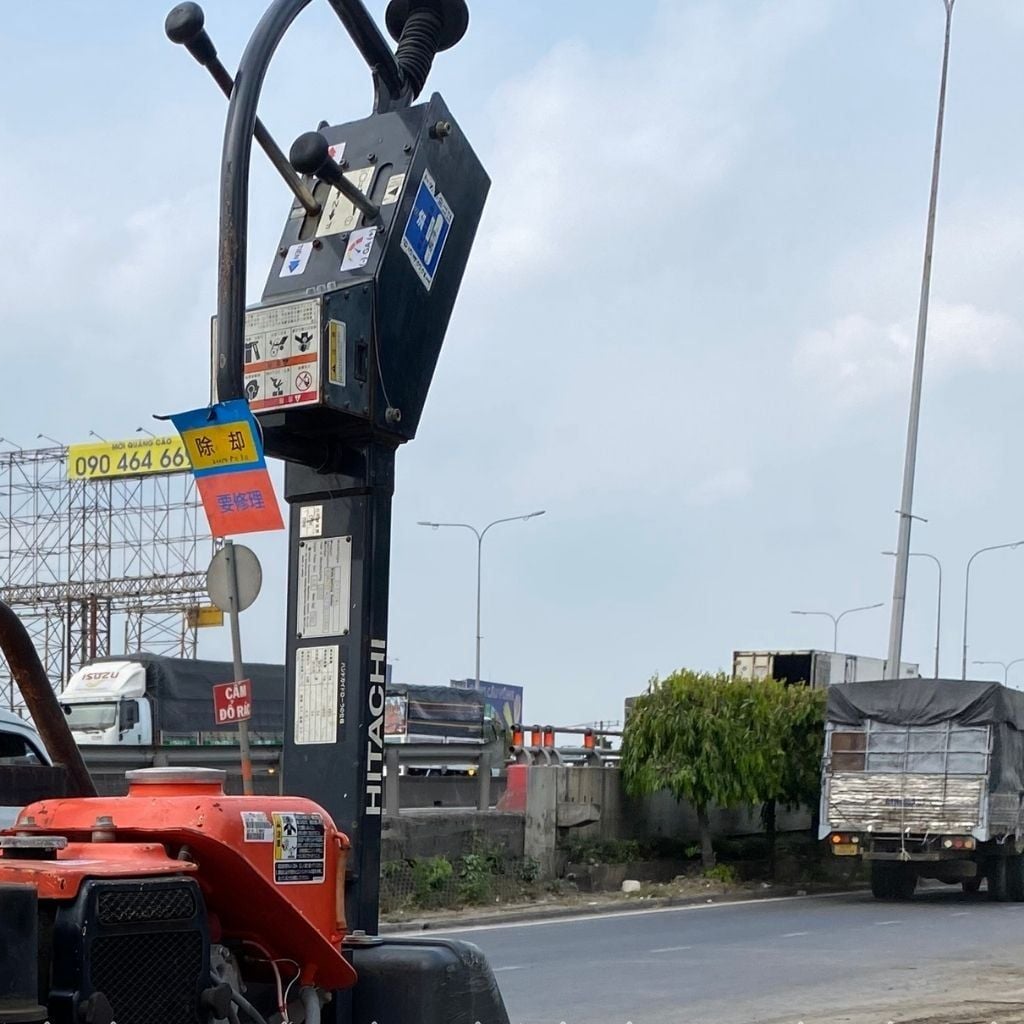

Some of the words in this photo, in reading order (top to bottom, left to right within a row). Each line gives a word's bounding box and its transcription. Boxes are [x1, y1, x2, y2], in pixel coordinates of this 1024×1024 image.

[195, 431, 246, 457] 除却
[75, 454, 111, 476] 090
[117, 450, 153, 472] 464
[217, 489, 265, 513] 要修理
[82, 671, 120, 681] ISUZU
[365, 639, 386, 816] HITACHI
